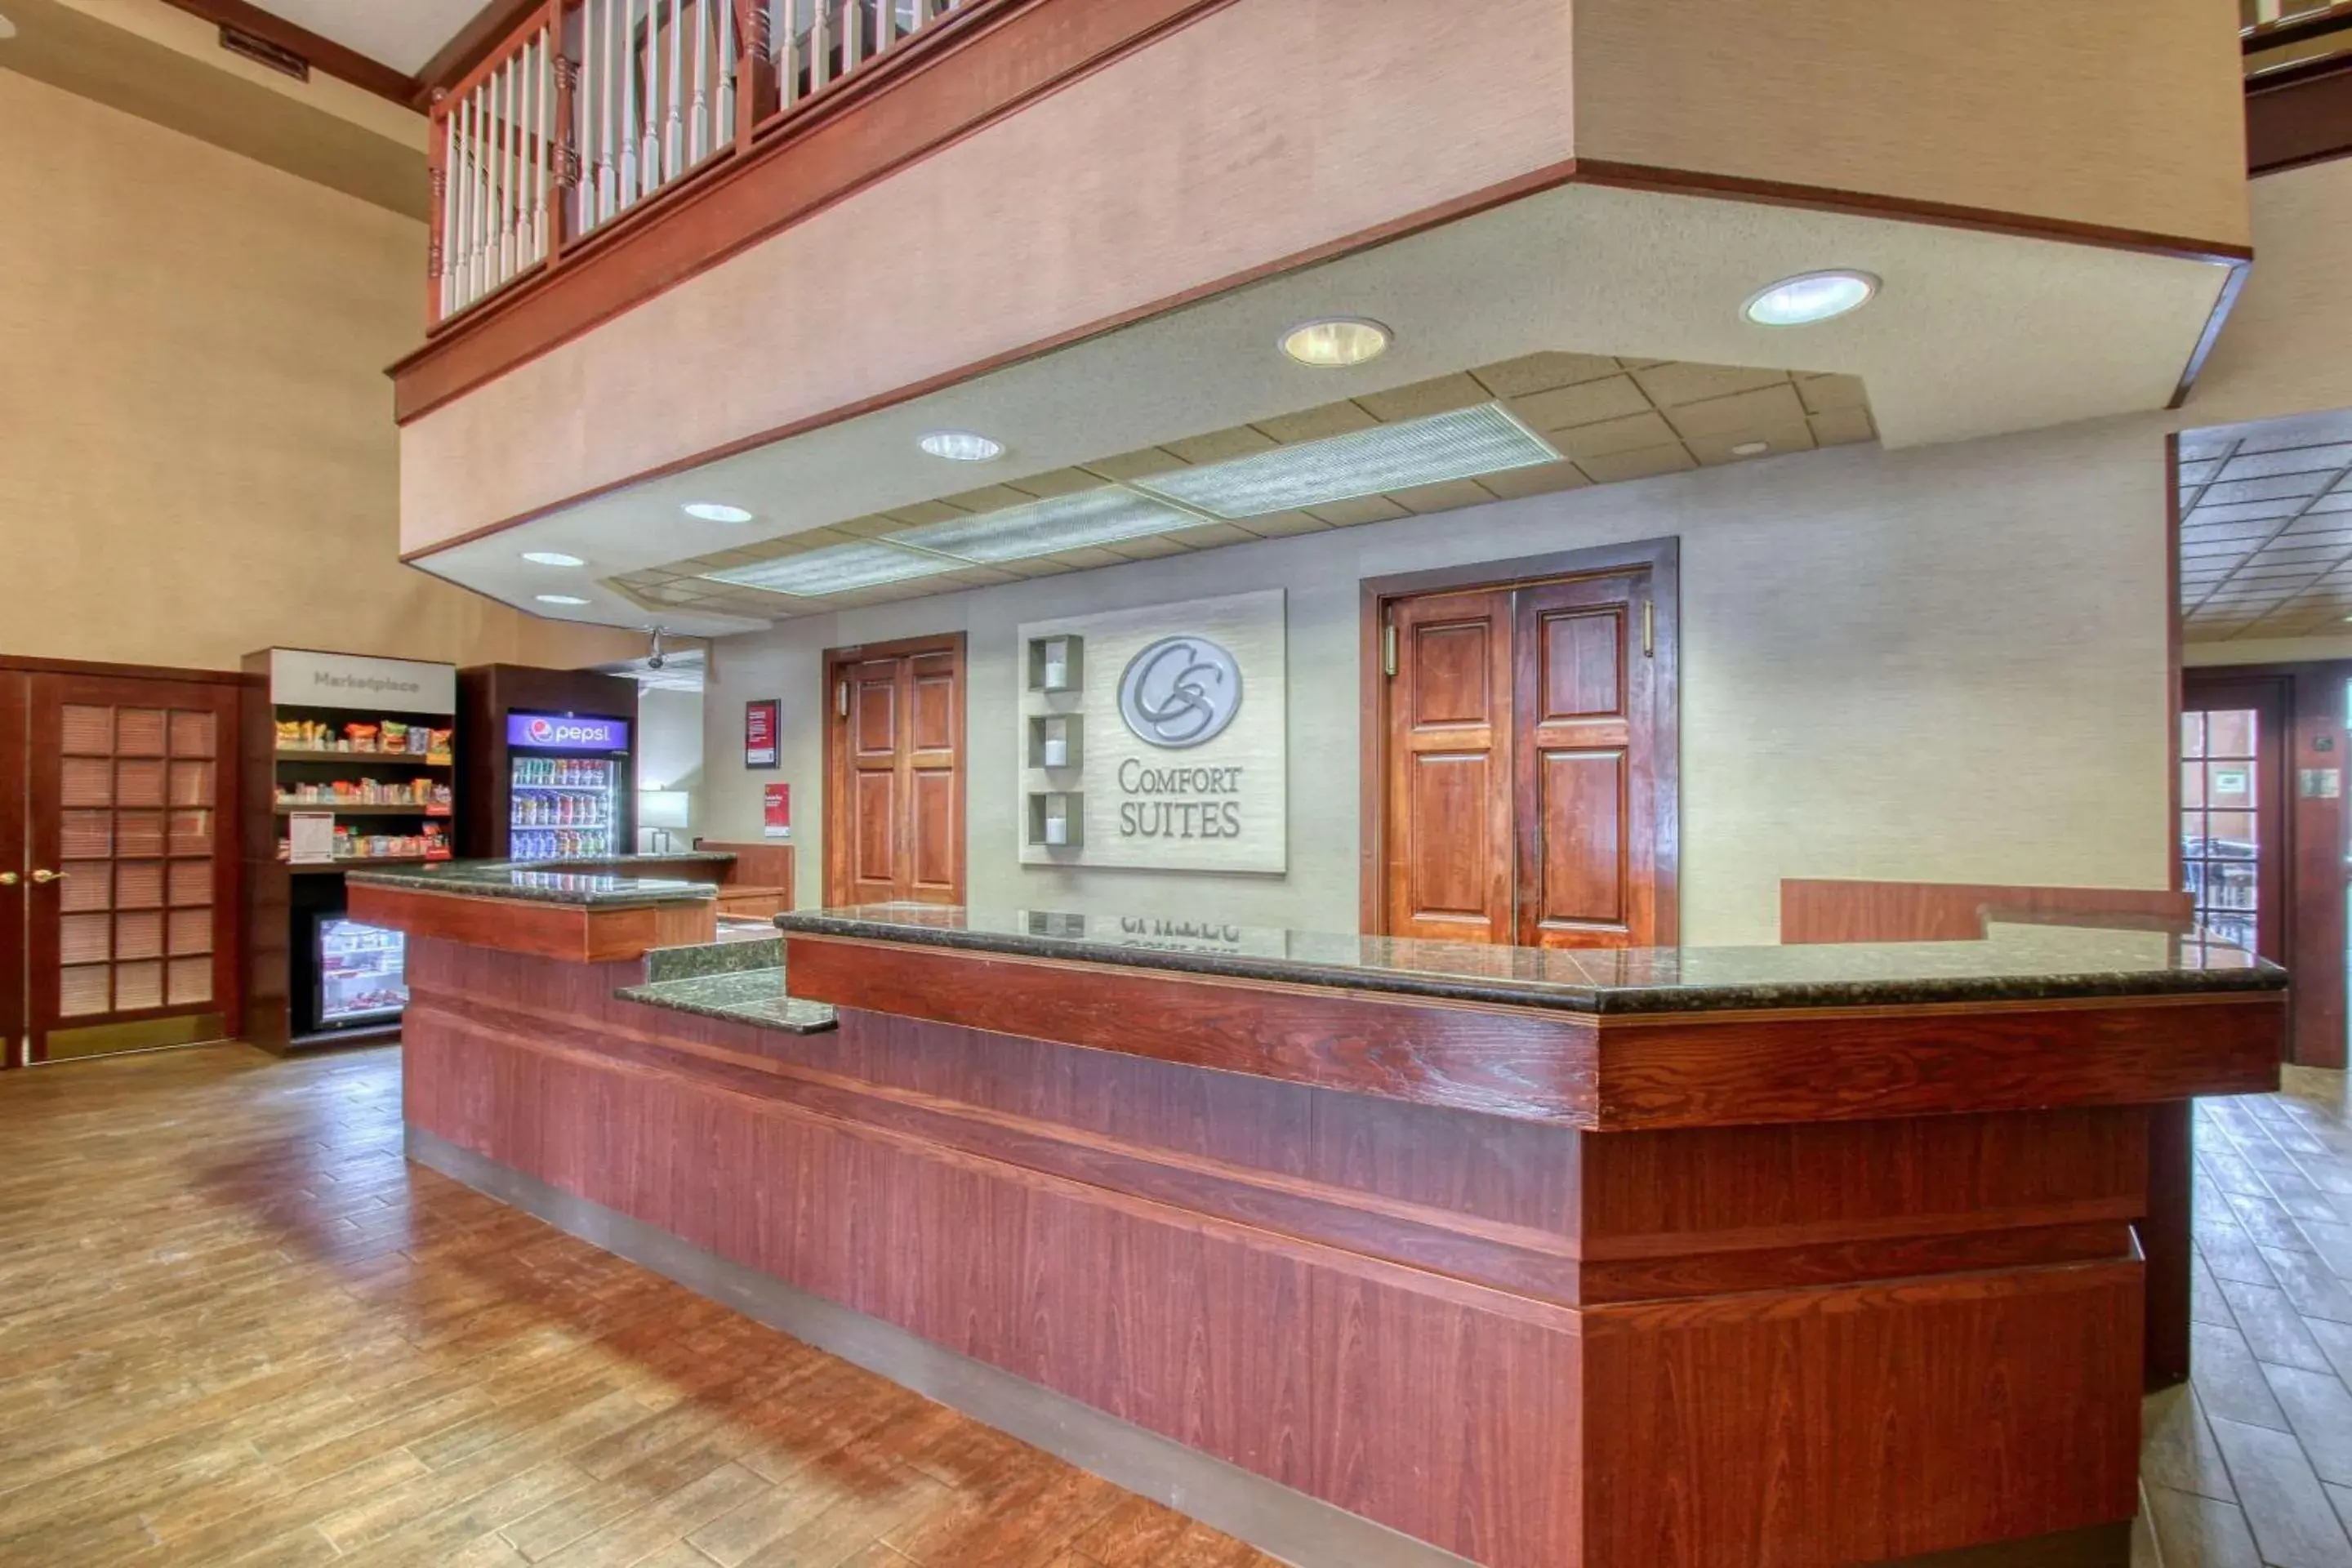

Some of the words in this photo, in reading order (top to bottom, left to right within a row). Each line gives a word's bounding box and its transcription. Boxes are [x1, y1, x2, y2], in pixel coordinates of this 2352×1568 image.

[314, 670, 420, 693] Marketplace
[555, 725, 611, 744] pepsi
[1120, 800, 1241, 839] SUITES
